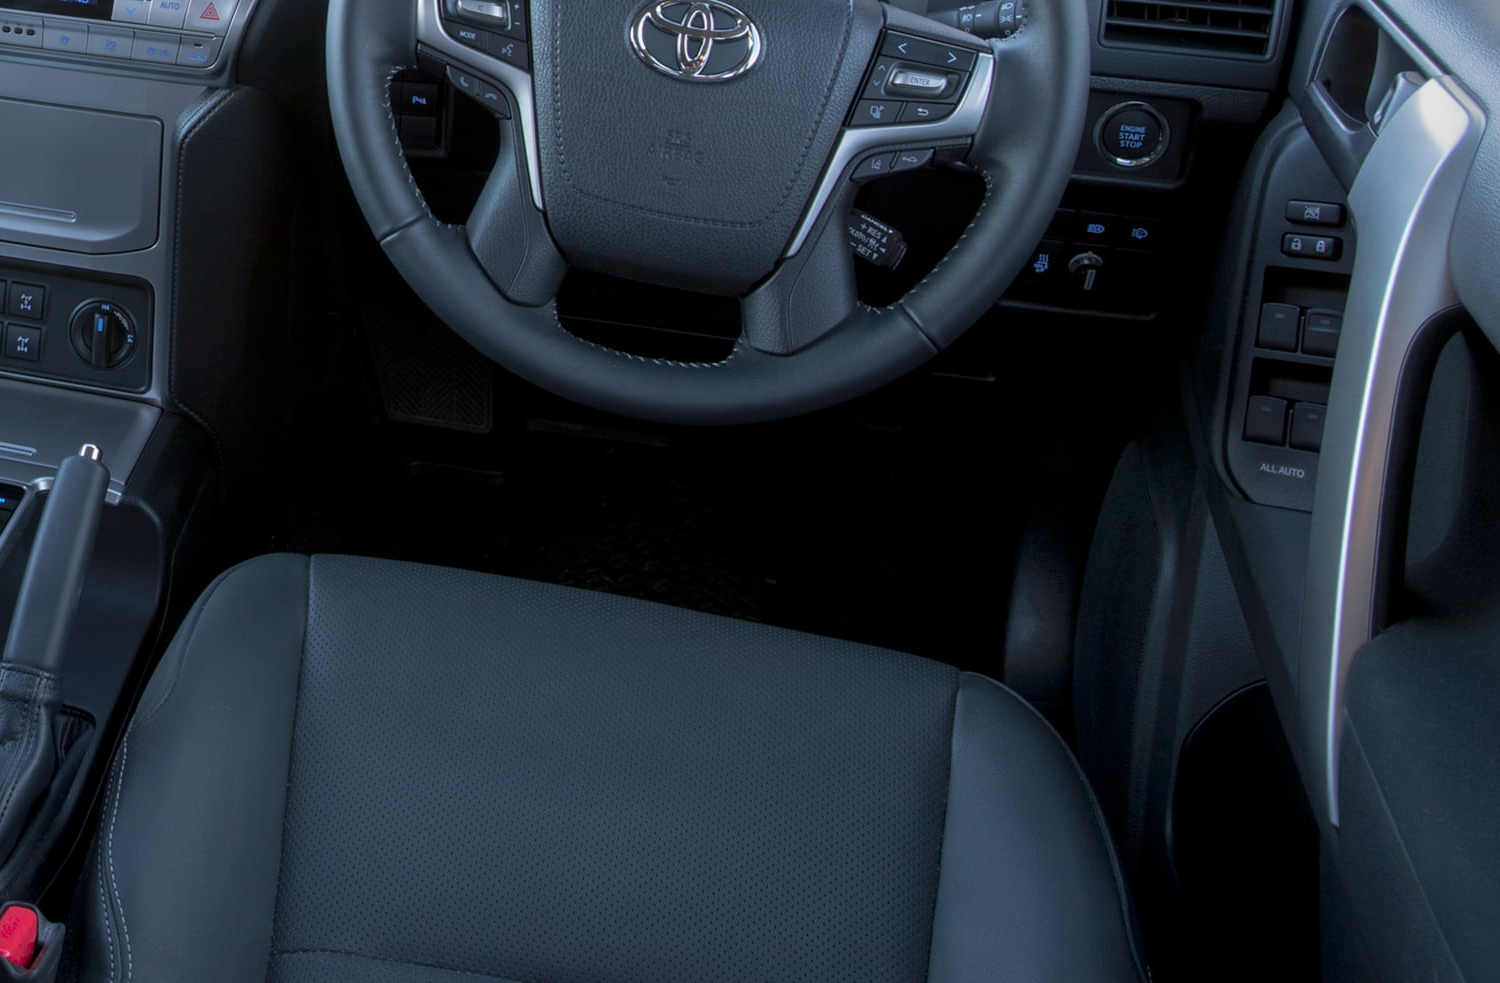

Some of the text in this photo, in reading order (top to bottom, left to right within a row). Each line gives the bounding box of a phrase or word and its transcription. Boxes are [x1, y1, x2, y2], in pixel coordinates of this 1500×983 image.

[160, 1, 180, 11] AUTO
[459, 30, 477, 40] MODE
[910, 77, 930, 87] ENTER
[1120, 124, 1146, 133] ENGINE
[1119, 132, 1146, 141] START
[1119, 140, 1143, 149] STOP
[867, 226, 882, 239] RES
[857, 244, 872, 257] SET
[1260, 462, 1305, 478] ALL AUTO
